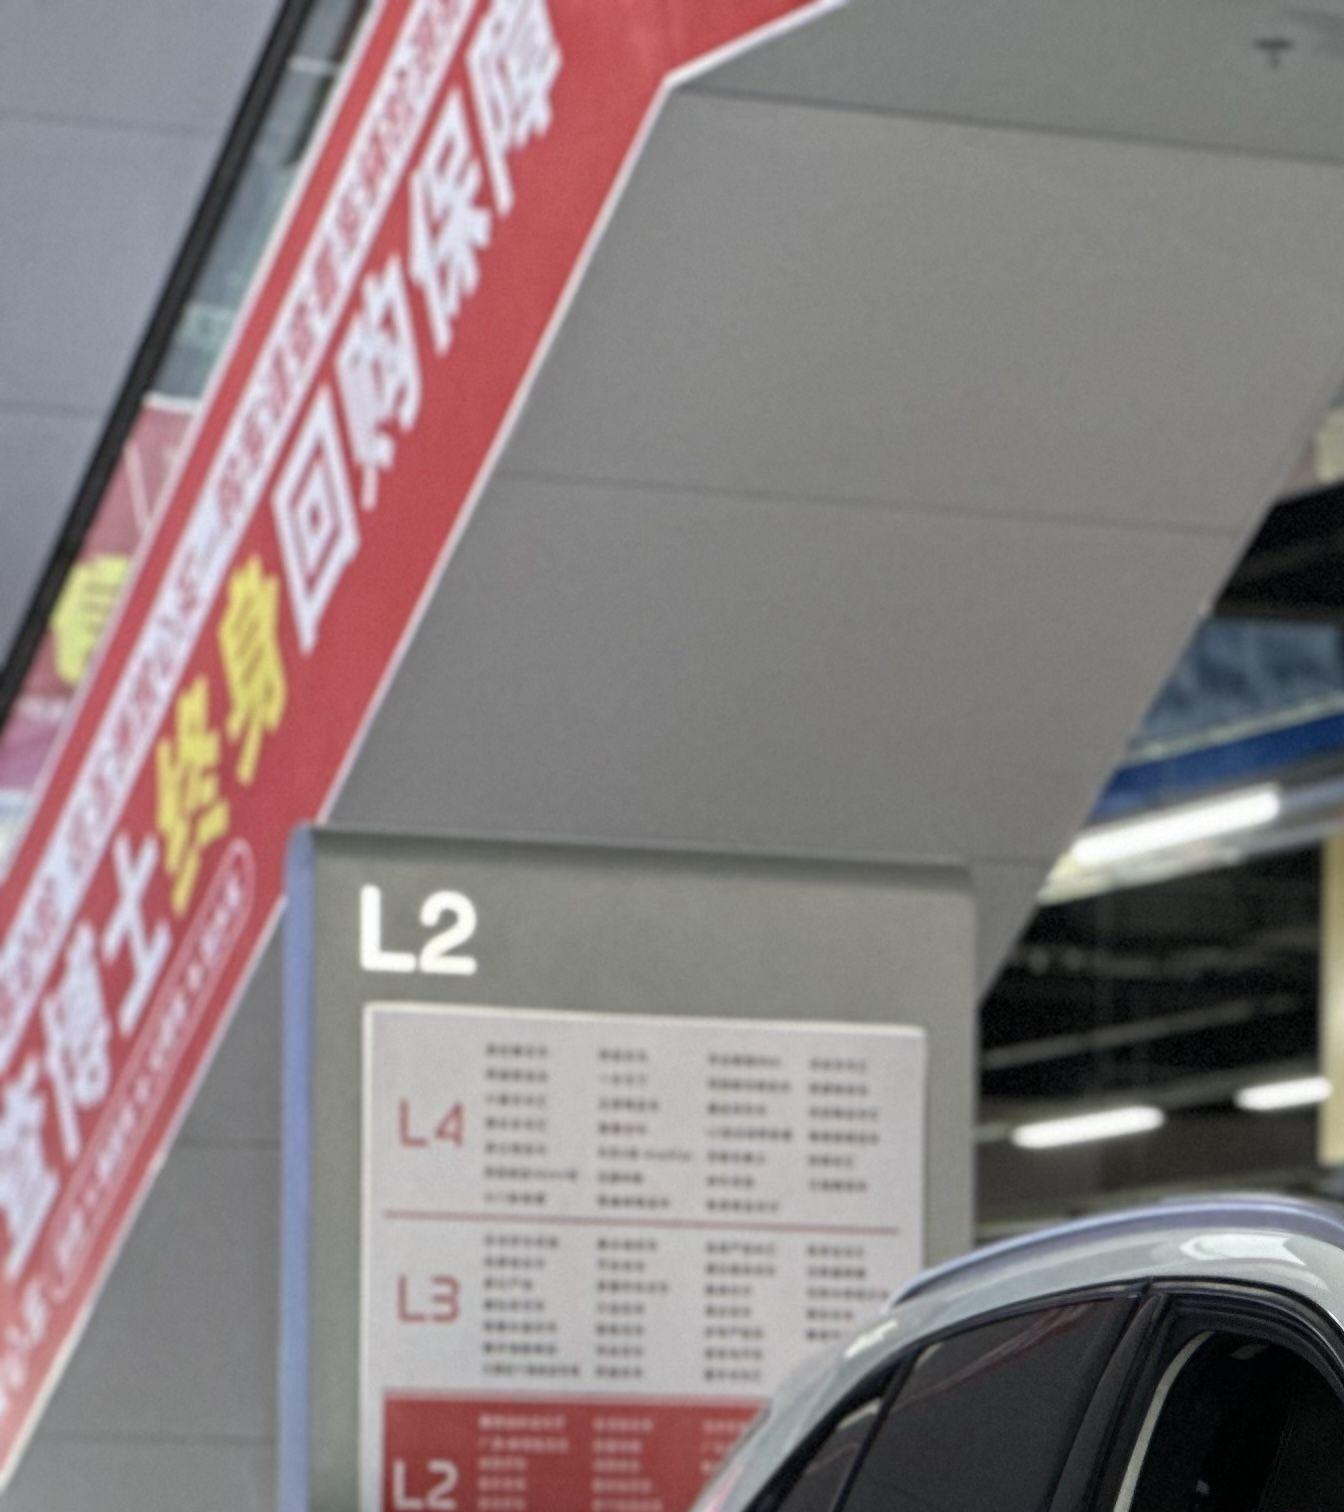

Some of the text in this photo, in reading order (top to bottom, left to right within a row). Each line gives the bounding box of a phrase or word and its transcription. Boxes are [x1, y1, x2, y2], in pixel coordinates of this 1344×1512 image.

[358, 884, 479, 976] L2
[396, 1097, 465, 1149] L4
[396, 1274, 462, 1324] L3
[391, 1459, 460, 1512] L2
